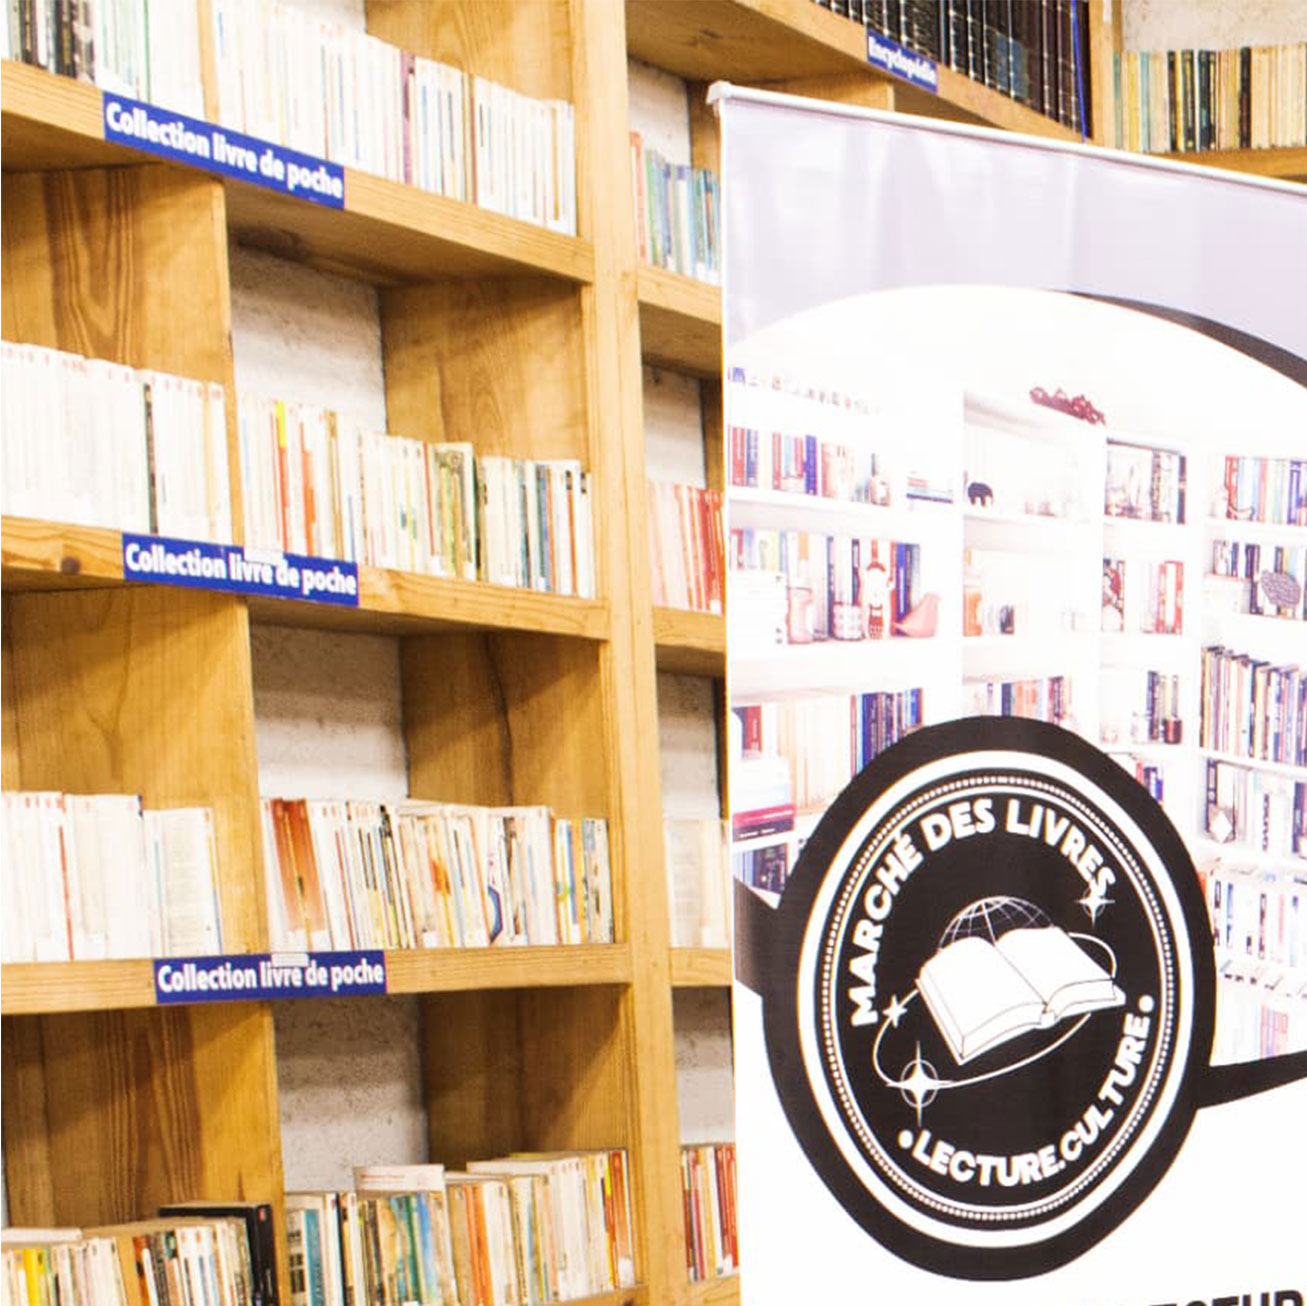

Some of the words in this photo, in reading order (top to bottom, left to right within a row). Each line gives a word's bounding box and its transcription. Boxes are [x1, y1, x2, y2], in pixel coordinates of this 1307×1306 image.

[106, 102, 210, 159] Collection
[211, 134, 258, 173] livre
[259, 149, 285, 180] de
[286, 163, 343, 198] poche
[125, 543, 226, 579] Collection
[229, 552, 273, 586] livre
[275, 556, 300, 588] de
[302, 566, 356, 597] poche
[849, 829, 925, 1027] MARCHÉ
[920, 798, 996, 852] DES
[1005, 798, 1117, 896] LIVRES
[157, 961, 256, 993] Collection
[259, 959, 301, 988] livre
[304, 957, 328, 988] de
[330, 957, 383, 992] poche
